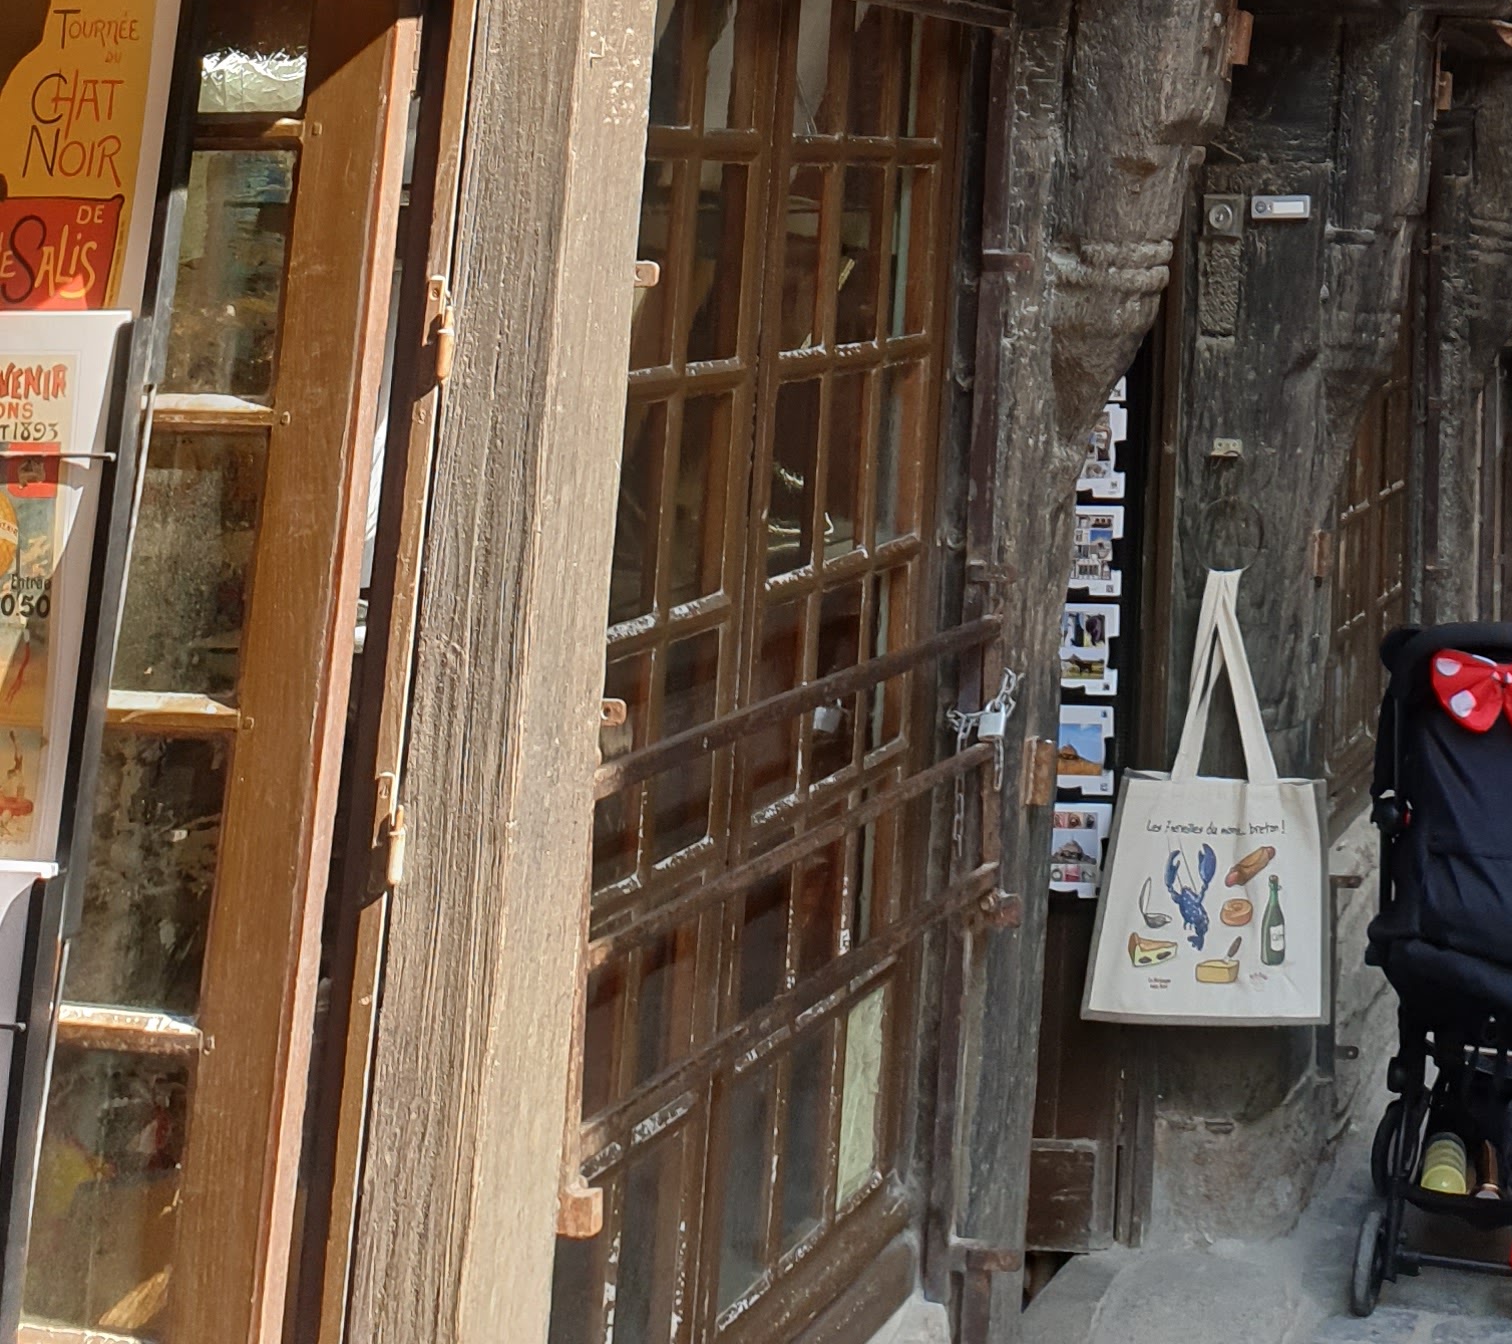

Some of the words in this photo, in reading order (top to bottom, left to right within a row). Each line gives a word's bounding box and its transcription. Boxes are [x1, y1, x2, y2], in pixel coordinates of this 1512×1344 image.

[32, 69, 124, 139] CHAT
[22, 125, 122, 188] NOIR
[76, 204, 105, 225] DE
[13, 422, 59, 441] 1893
